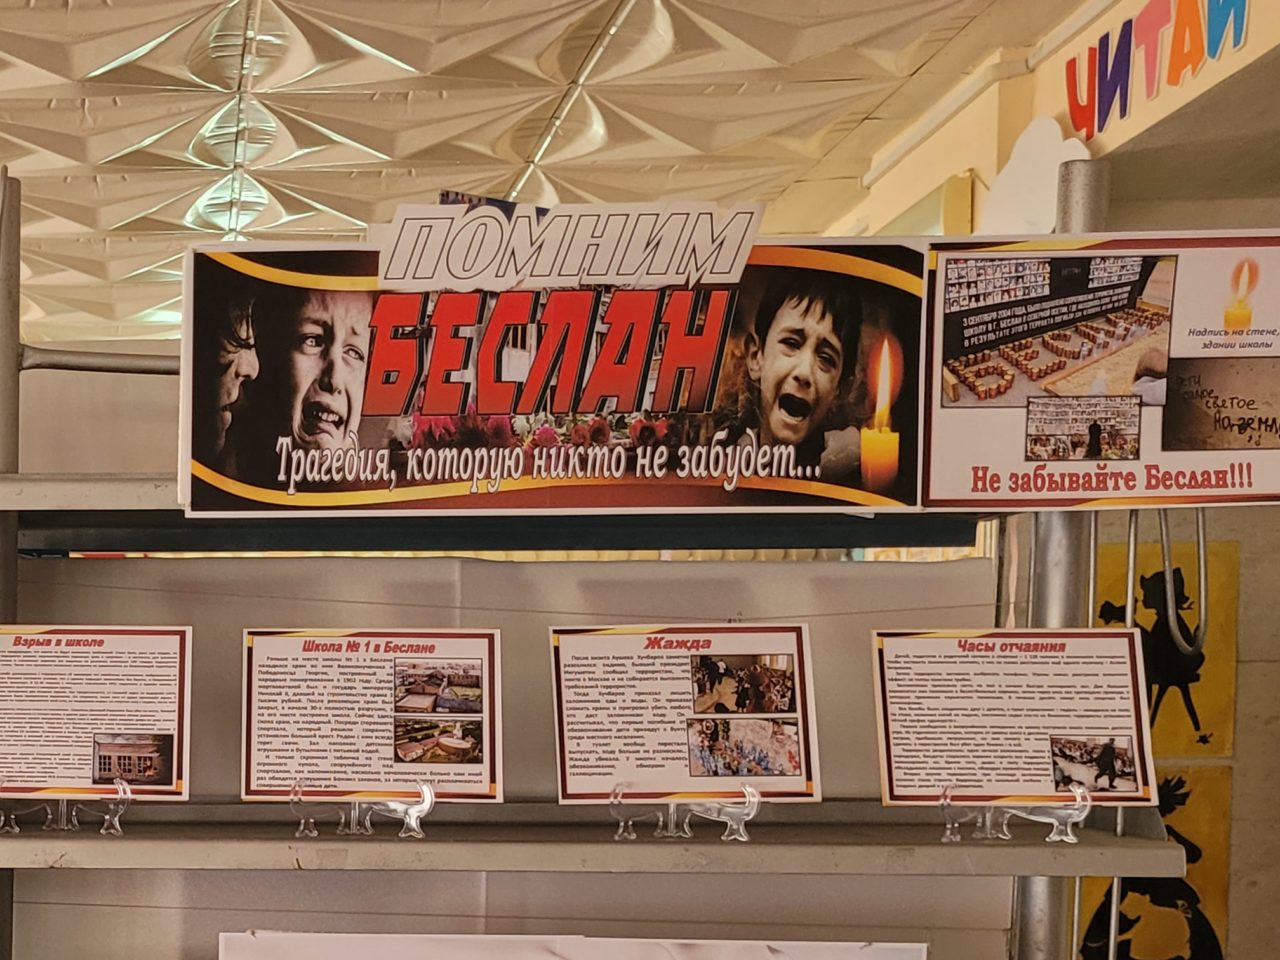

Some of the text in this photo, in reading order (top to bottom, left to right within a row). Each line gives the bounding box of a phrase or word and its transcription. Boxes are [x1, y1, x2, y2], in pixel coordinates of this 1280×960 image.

[386, 213, 753, 283] ПОМНИМ
[1239, 340, 1273, 348] школы
[363, 289, 727, 418] БЕСЛАН
[274, 430, 822, 495] Трагедия, которую никто не забудет...
[971, 458, 1255, 495] Не забывайте Беслан!!!
[13, 636, 104, 648] Взрыв в школе
[302, 640, 435, 654] Школа № 1 в Беслане
[644, 637, 712, 651] Жажда
[958, 640, 1066, 653] Часы отчаяния
